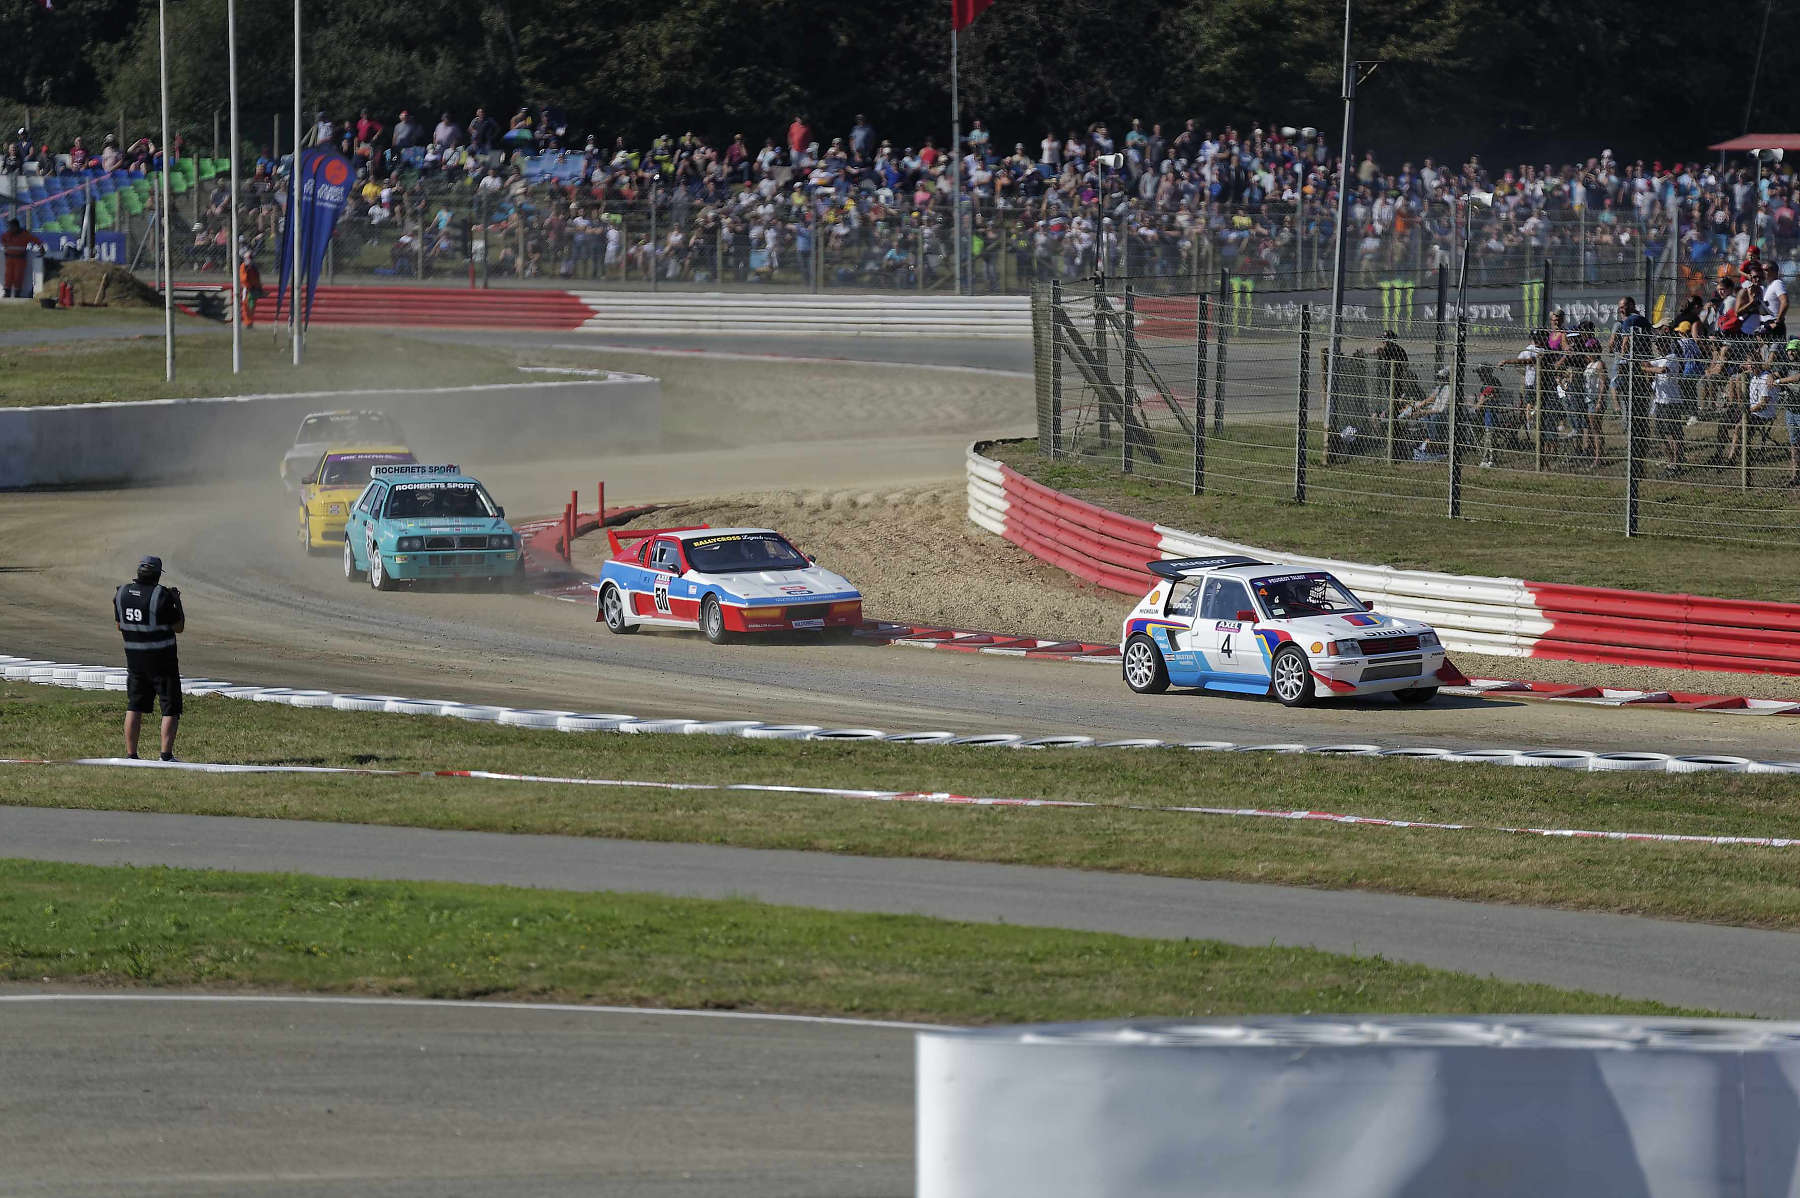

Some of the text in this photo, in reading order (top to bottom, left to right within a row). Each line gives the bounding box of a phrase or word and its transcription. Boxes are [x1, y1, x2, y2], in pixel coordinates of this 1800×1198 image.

[1263, 301, 1368, 321] MOSER
[1554, 300, 1646, 323] MONSTR
[375, 464, 457, 475] ROCHERETS SPORT
[395, 482, 446, 491] ROCHERETS
[692, 535, 741, 547] RALLYCROSS
[1170, 558, 1227, 567] PEUGEOT
[655, 587, 669, 611] 50
[125, 607, 143, 622] 59
[1218, 620, 1240, 629] AXEL
[1364, 628, 1408, 637] Shell
[1220, 633, 1233, 659] 4
